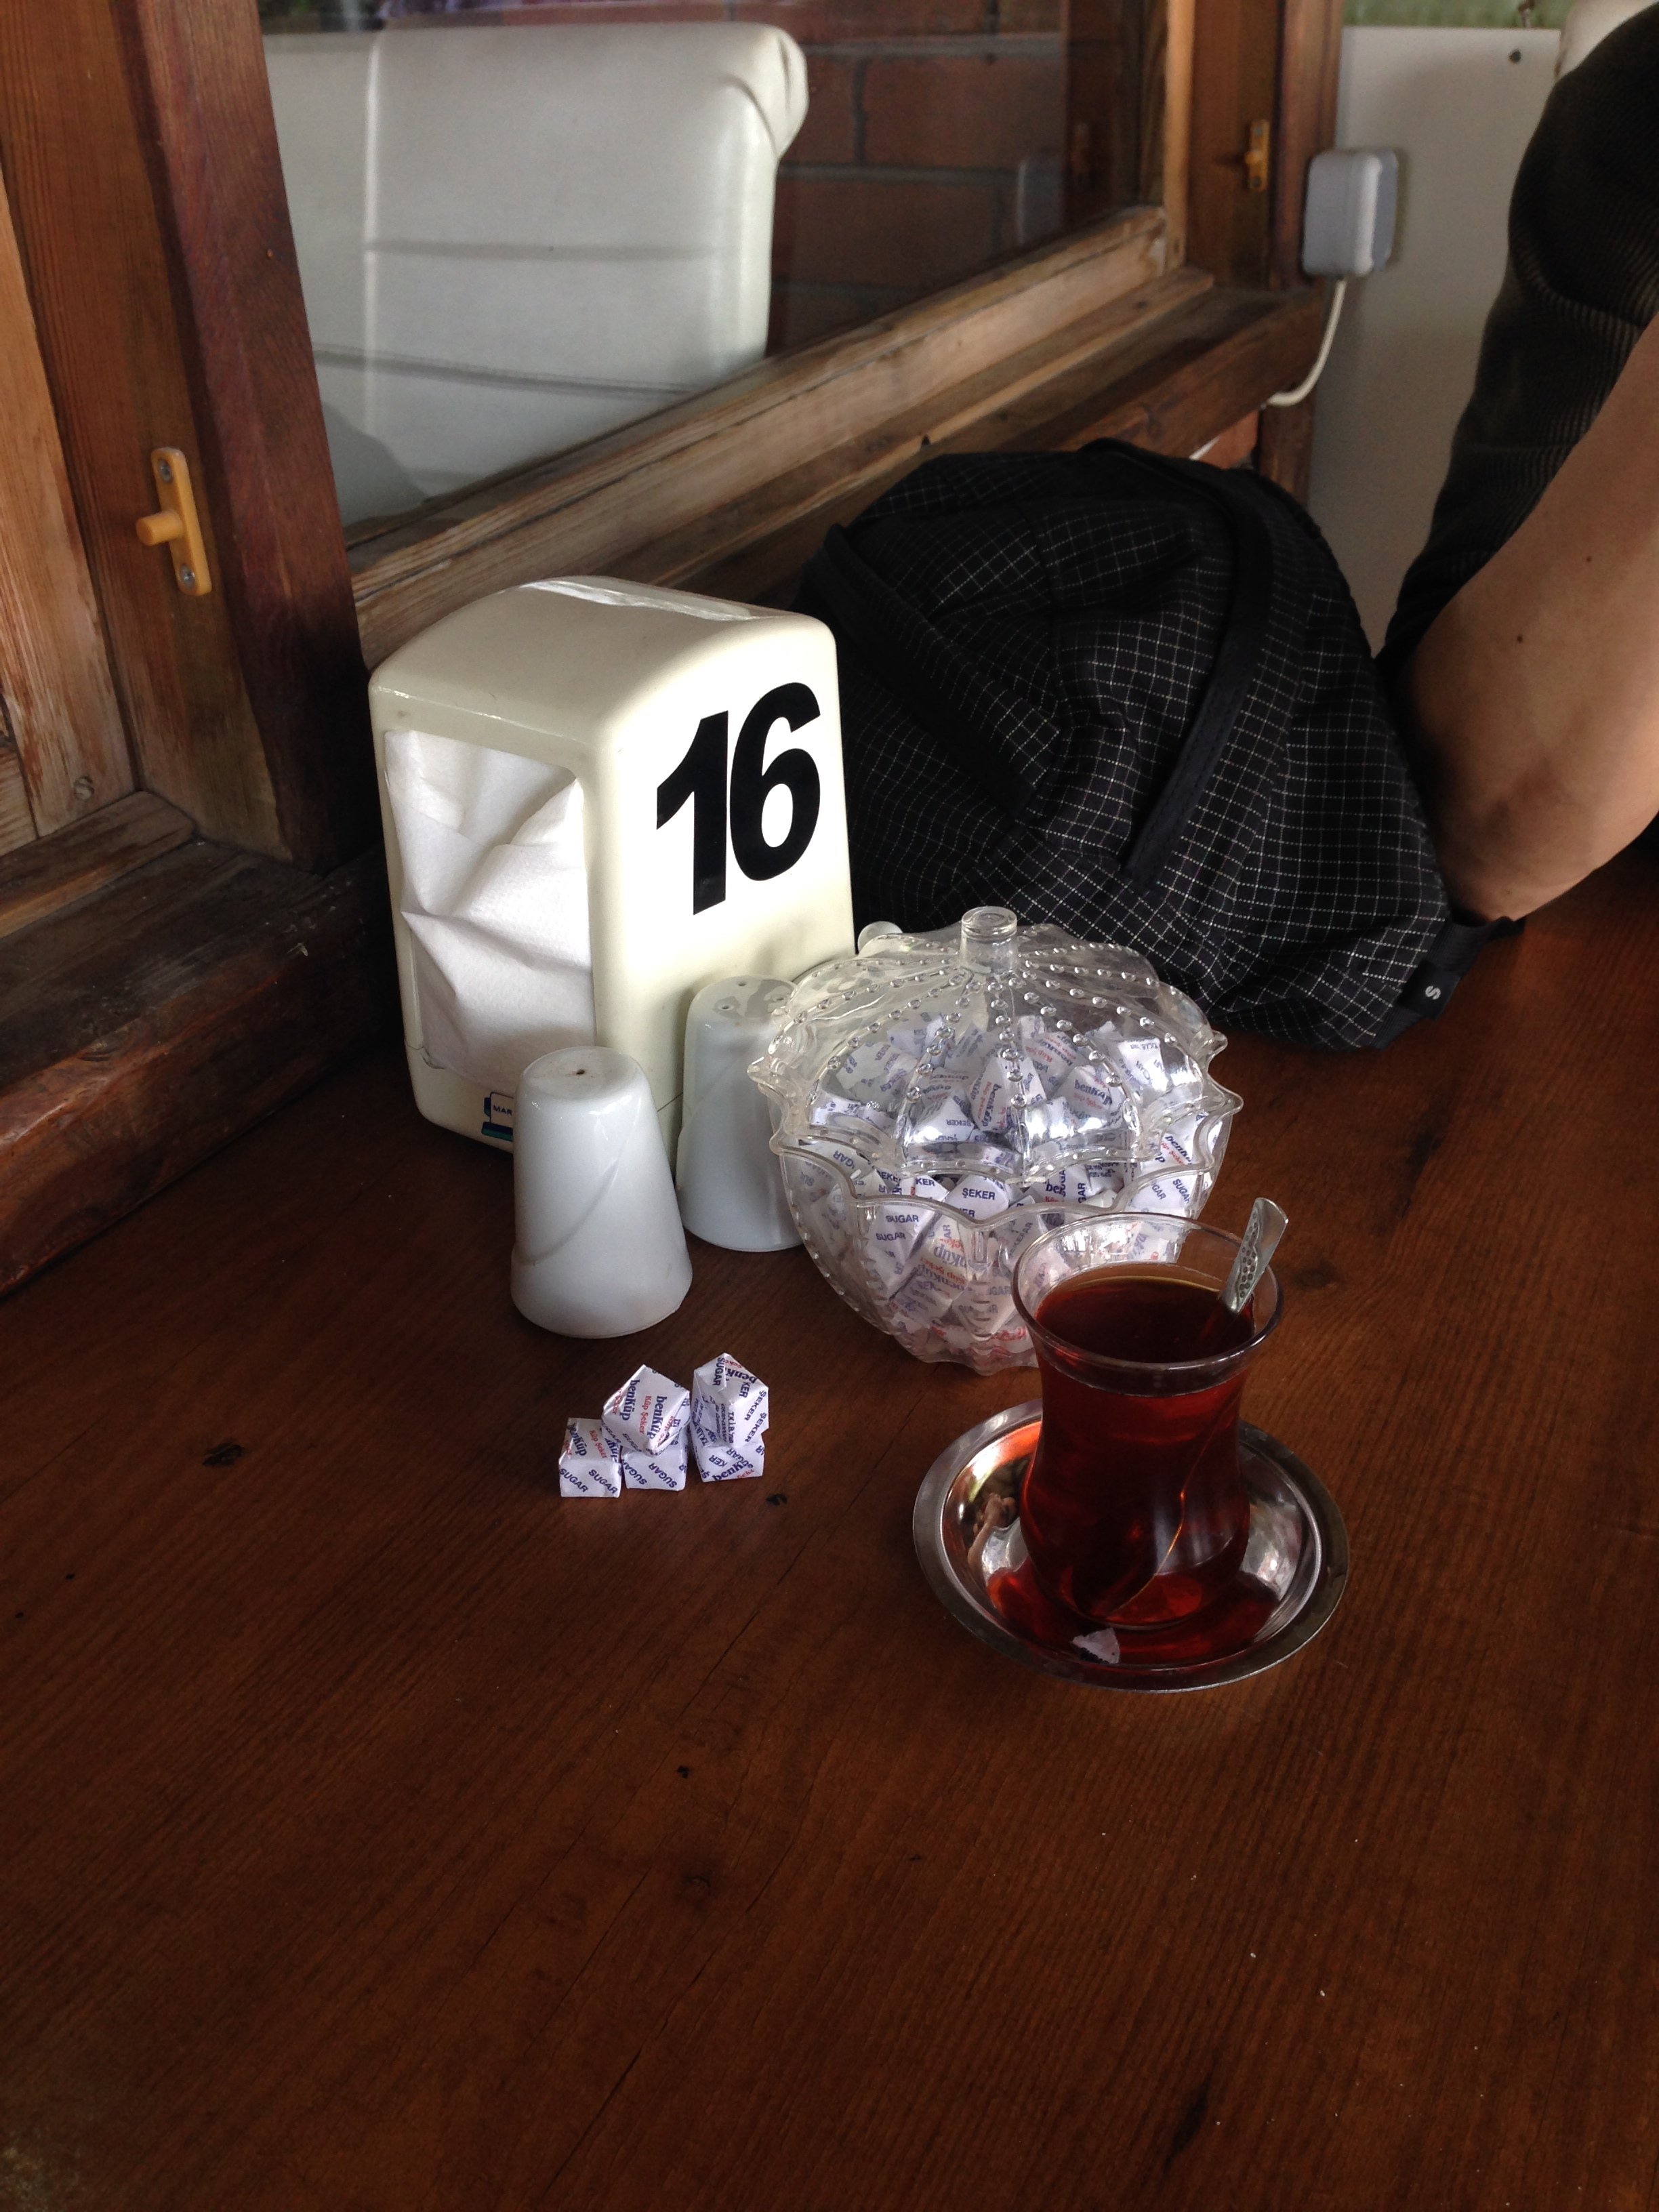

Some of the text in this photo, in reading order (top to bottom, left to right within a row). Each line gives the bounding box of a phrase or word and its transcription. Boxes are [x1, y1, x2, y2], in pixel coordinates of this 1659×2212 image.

[657, 682, 821, 915] 16
[493, 1105, 513, 1117] MAR
[962, 1187, 995, 1200] ŞEKER
[886, 1214, 919, 1223] SUGAR
[876, 1232, 905, 1241] SUGAR
[712, 1357, 725, 1386] SUGAR
[744, 1390, 767, 1420] ŞEKER
[745, 1412, 767, 1442] ŞEKER
[560, 1468, 589, 1492] SUGAR
[588, 1469, 618, 1494] SUGAR
[649, 1462, 677, 1488] SUGAR
